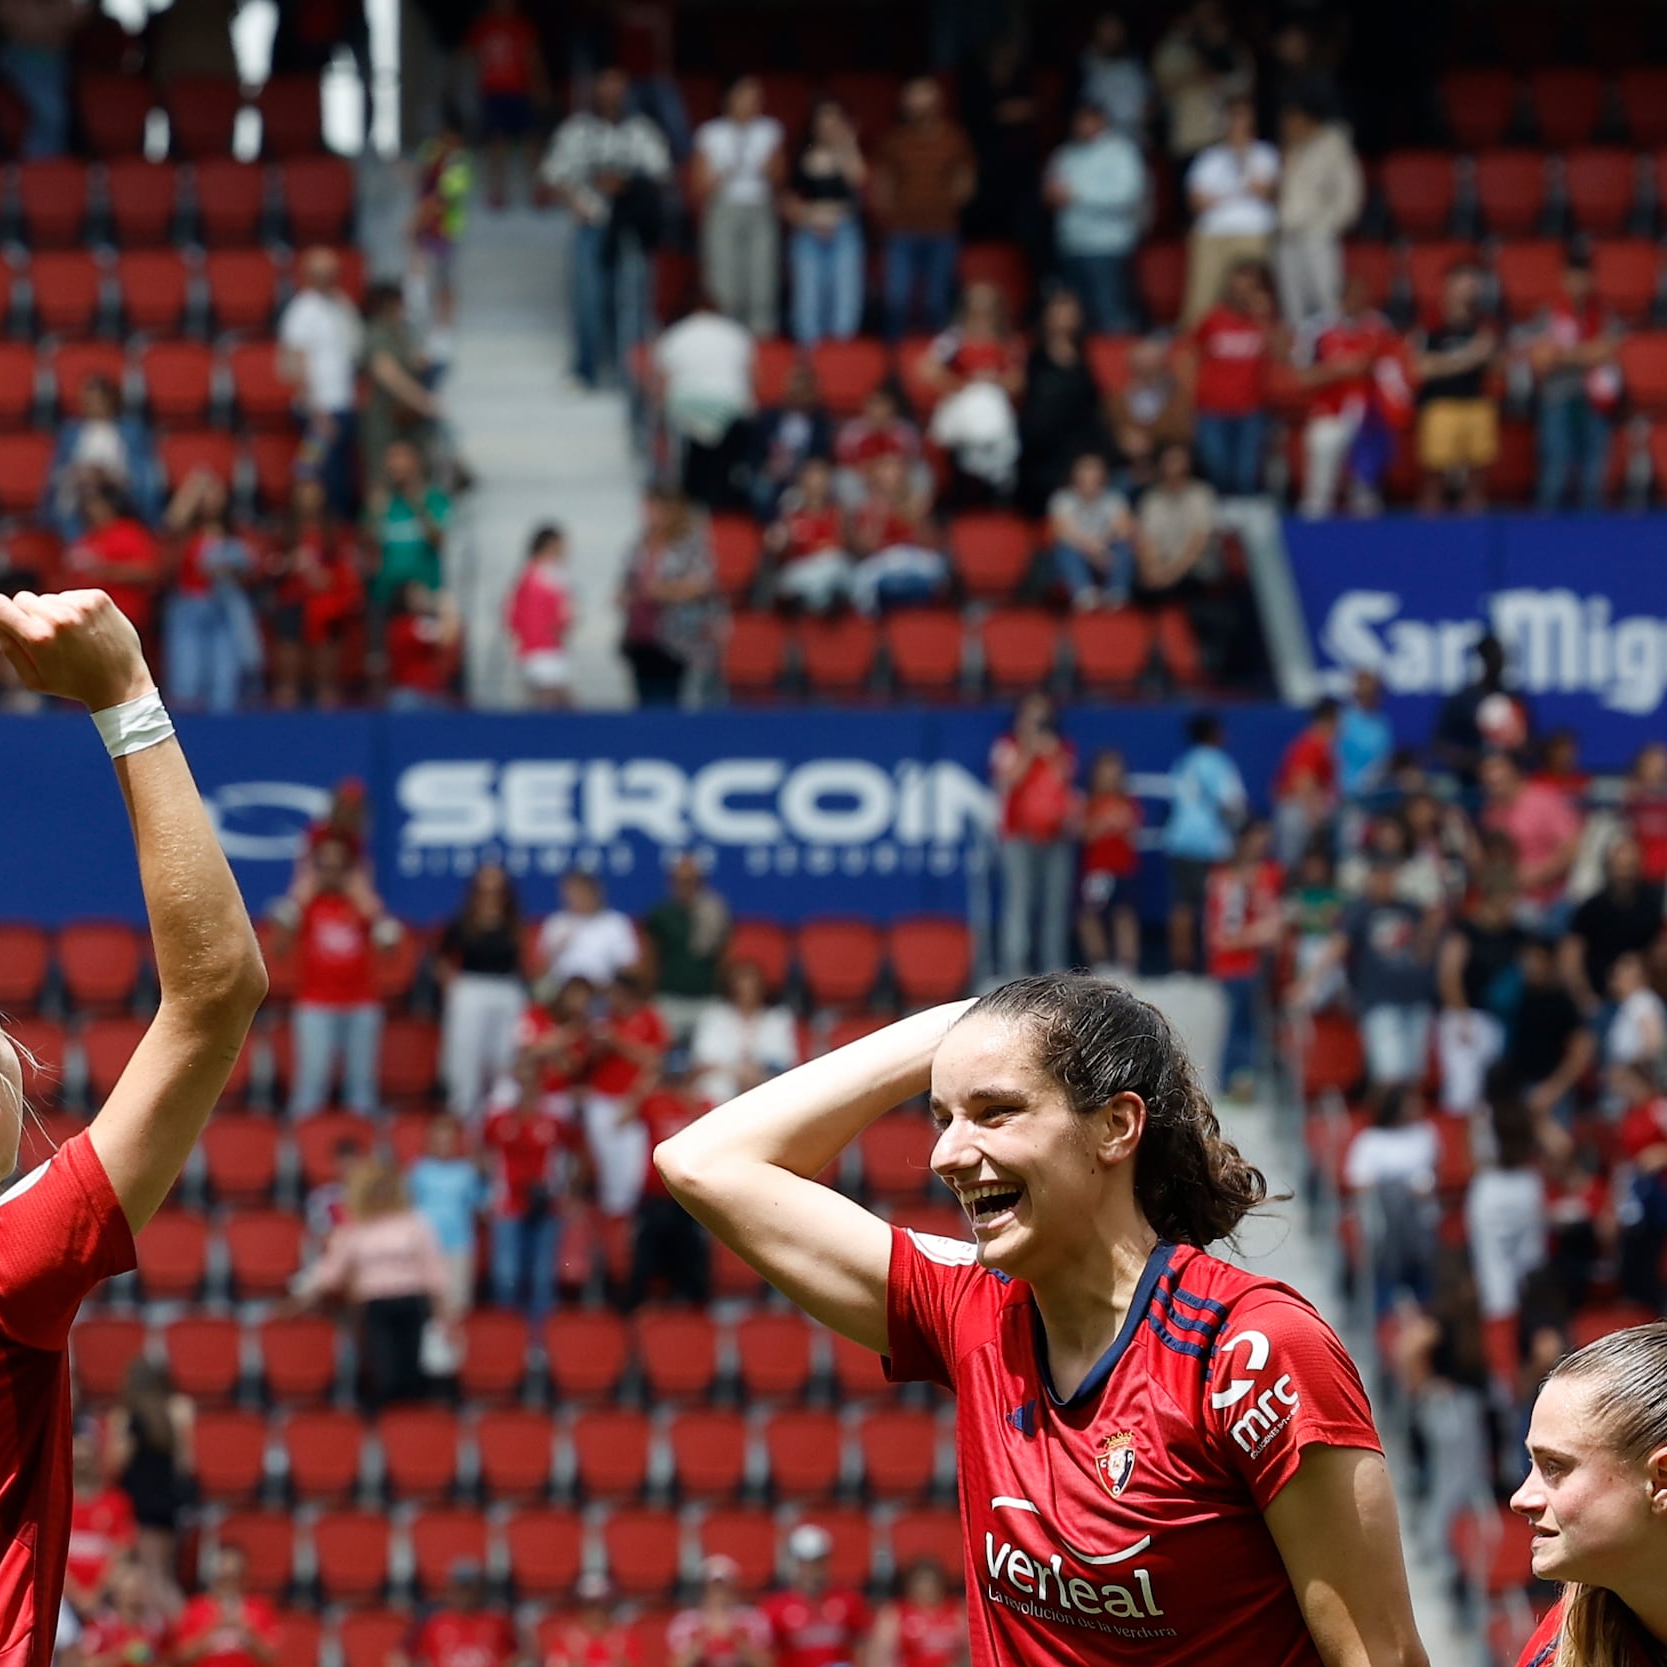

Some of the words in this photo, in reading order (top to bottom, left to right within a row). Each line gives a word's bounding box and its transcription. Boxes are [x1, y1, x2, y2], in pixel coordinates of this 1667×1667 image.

[1230, 1373, 1299, 1453] mrc
[985, 1531, 1164, 1619] verleal
[988, 1584, 1004, 1604] La
[1098, 1619, 1112, 1634] la
[1114, 1621, 1178, 1639] verdura
